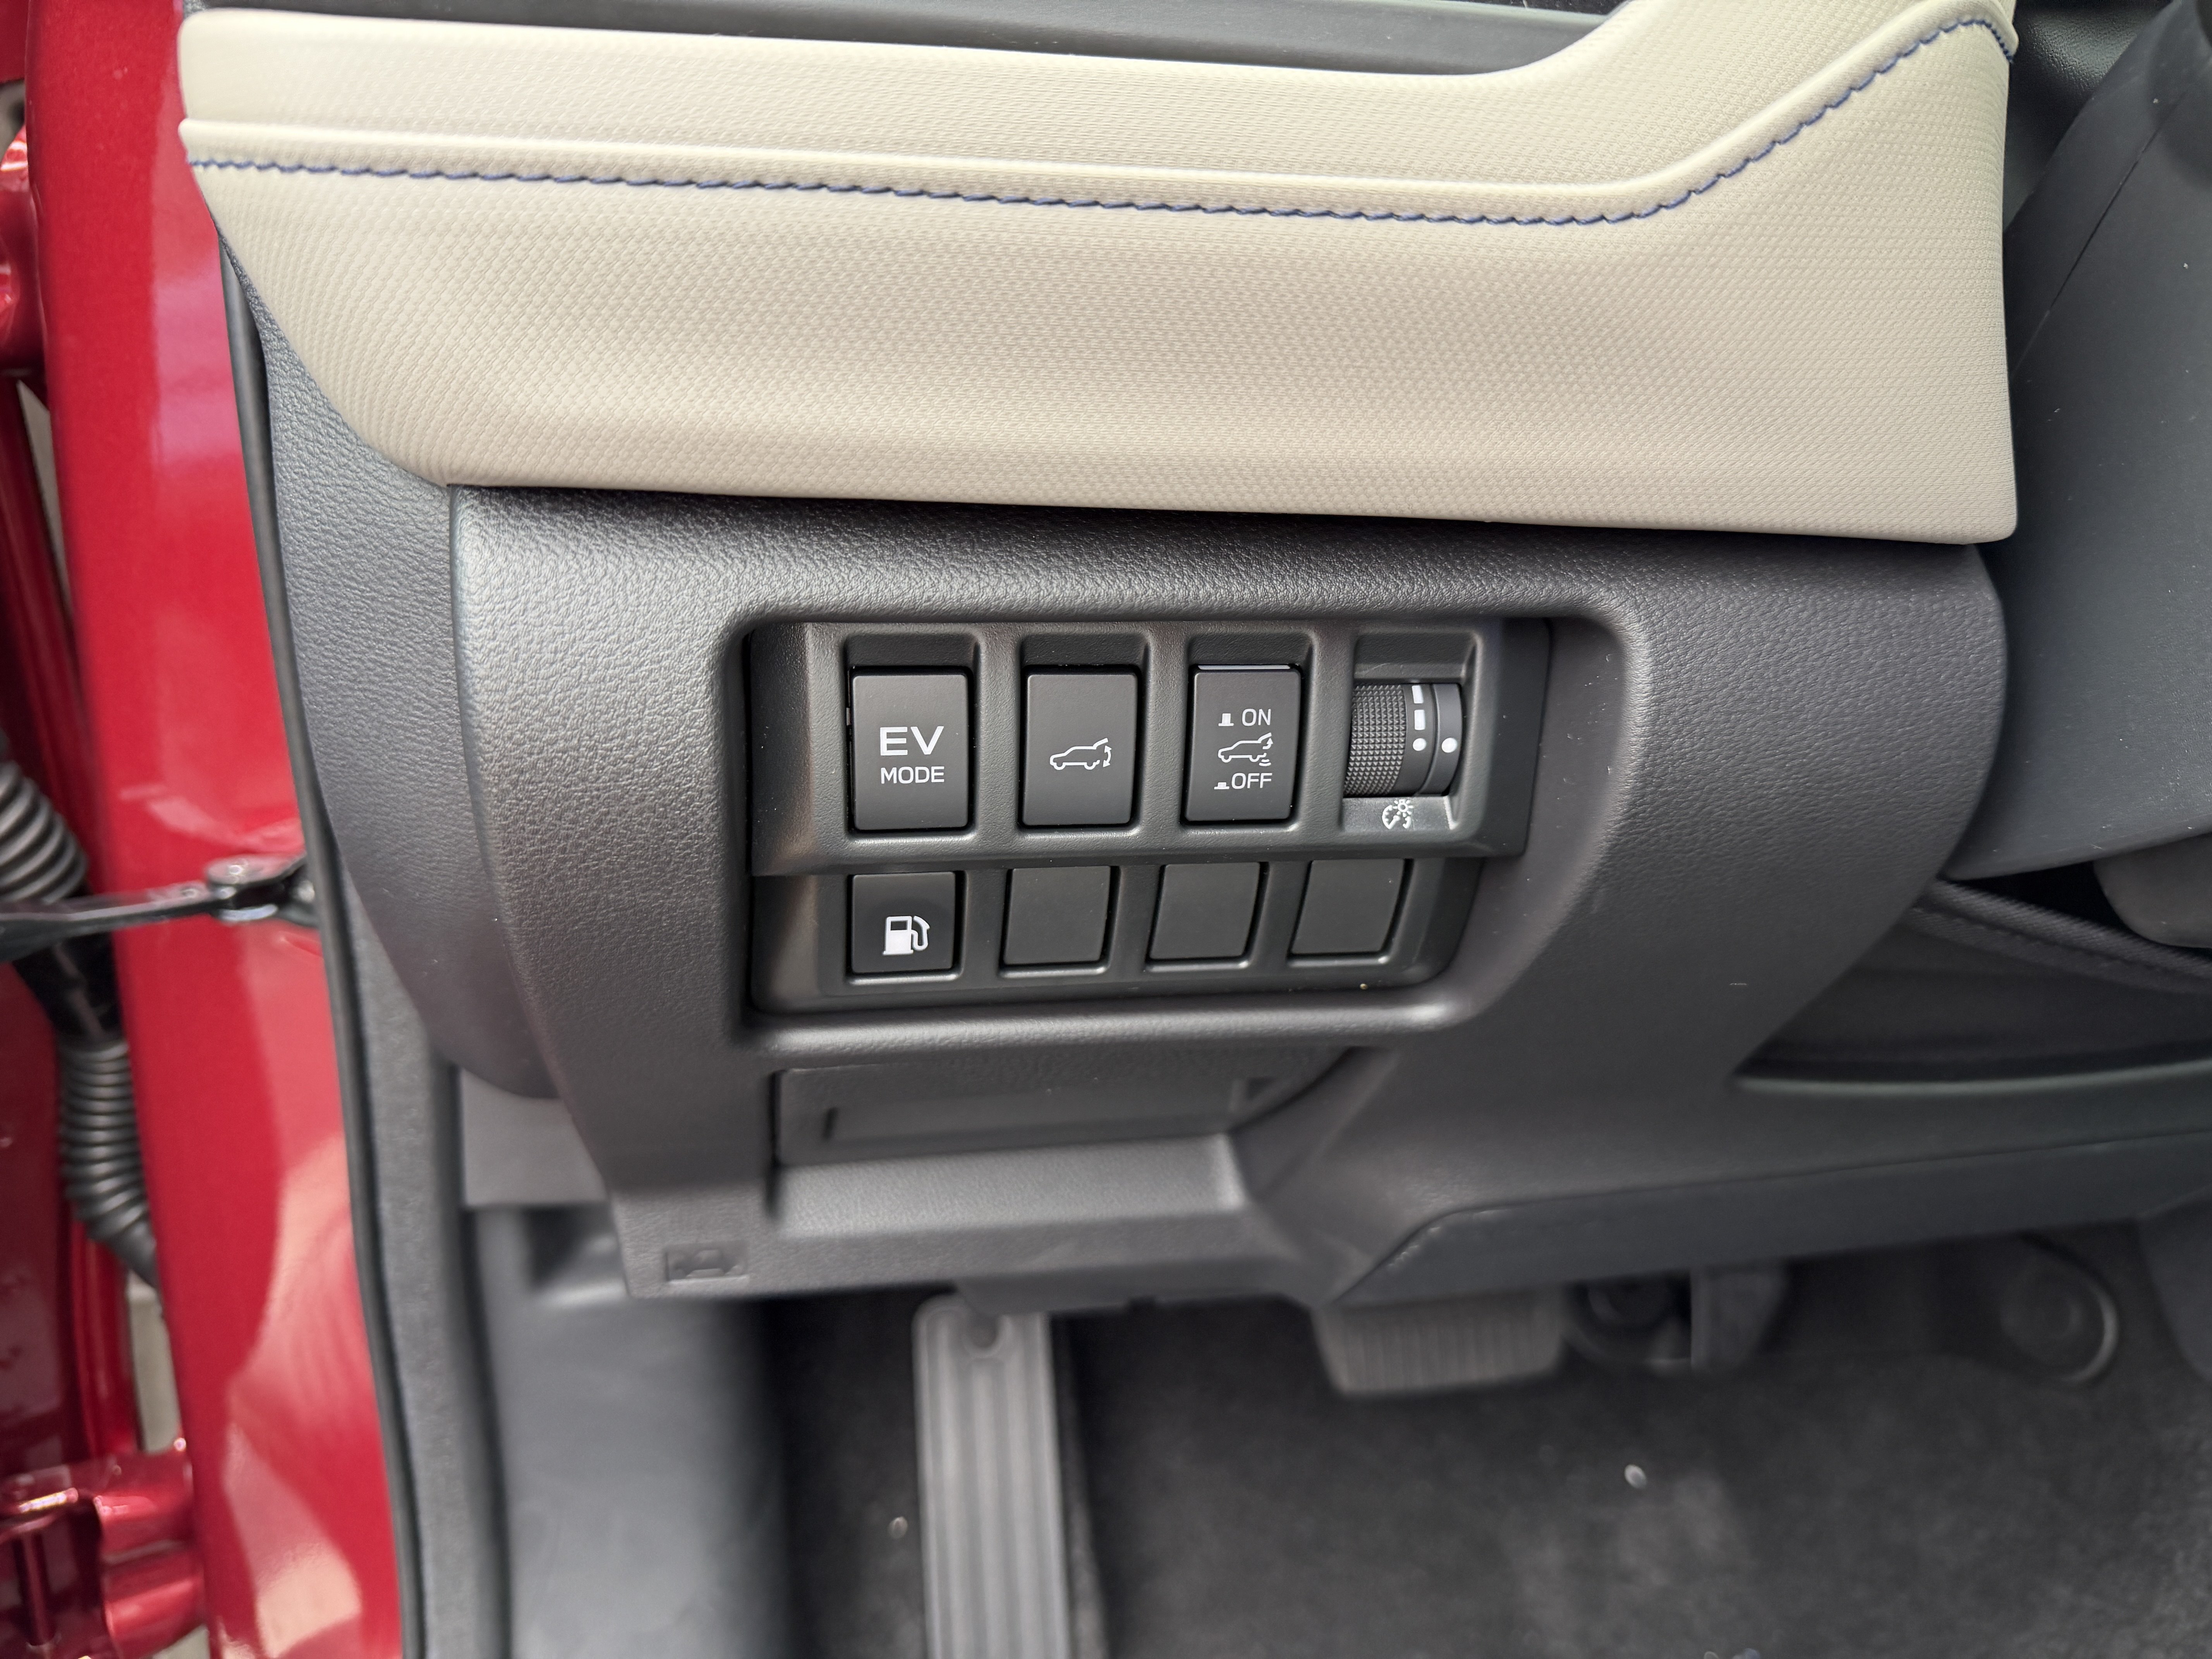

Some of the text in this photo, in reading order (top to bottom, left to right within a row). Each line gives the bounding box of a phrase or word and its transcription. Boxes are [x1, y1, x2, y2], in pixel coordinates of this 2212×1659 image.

[1242, 708, 1271, 726] ON
[879, 725, 944, 756] EV
[880, 766, 945, 784] MODE
[1231, 772, 1273, 789] OFF
